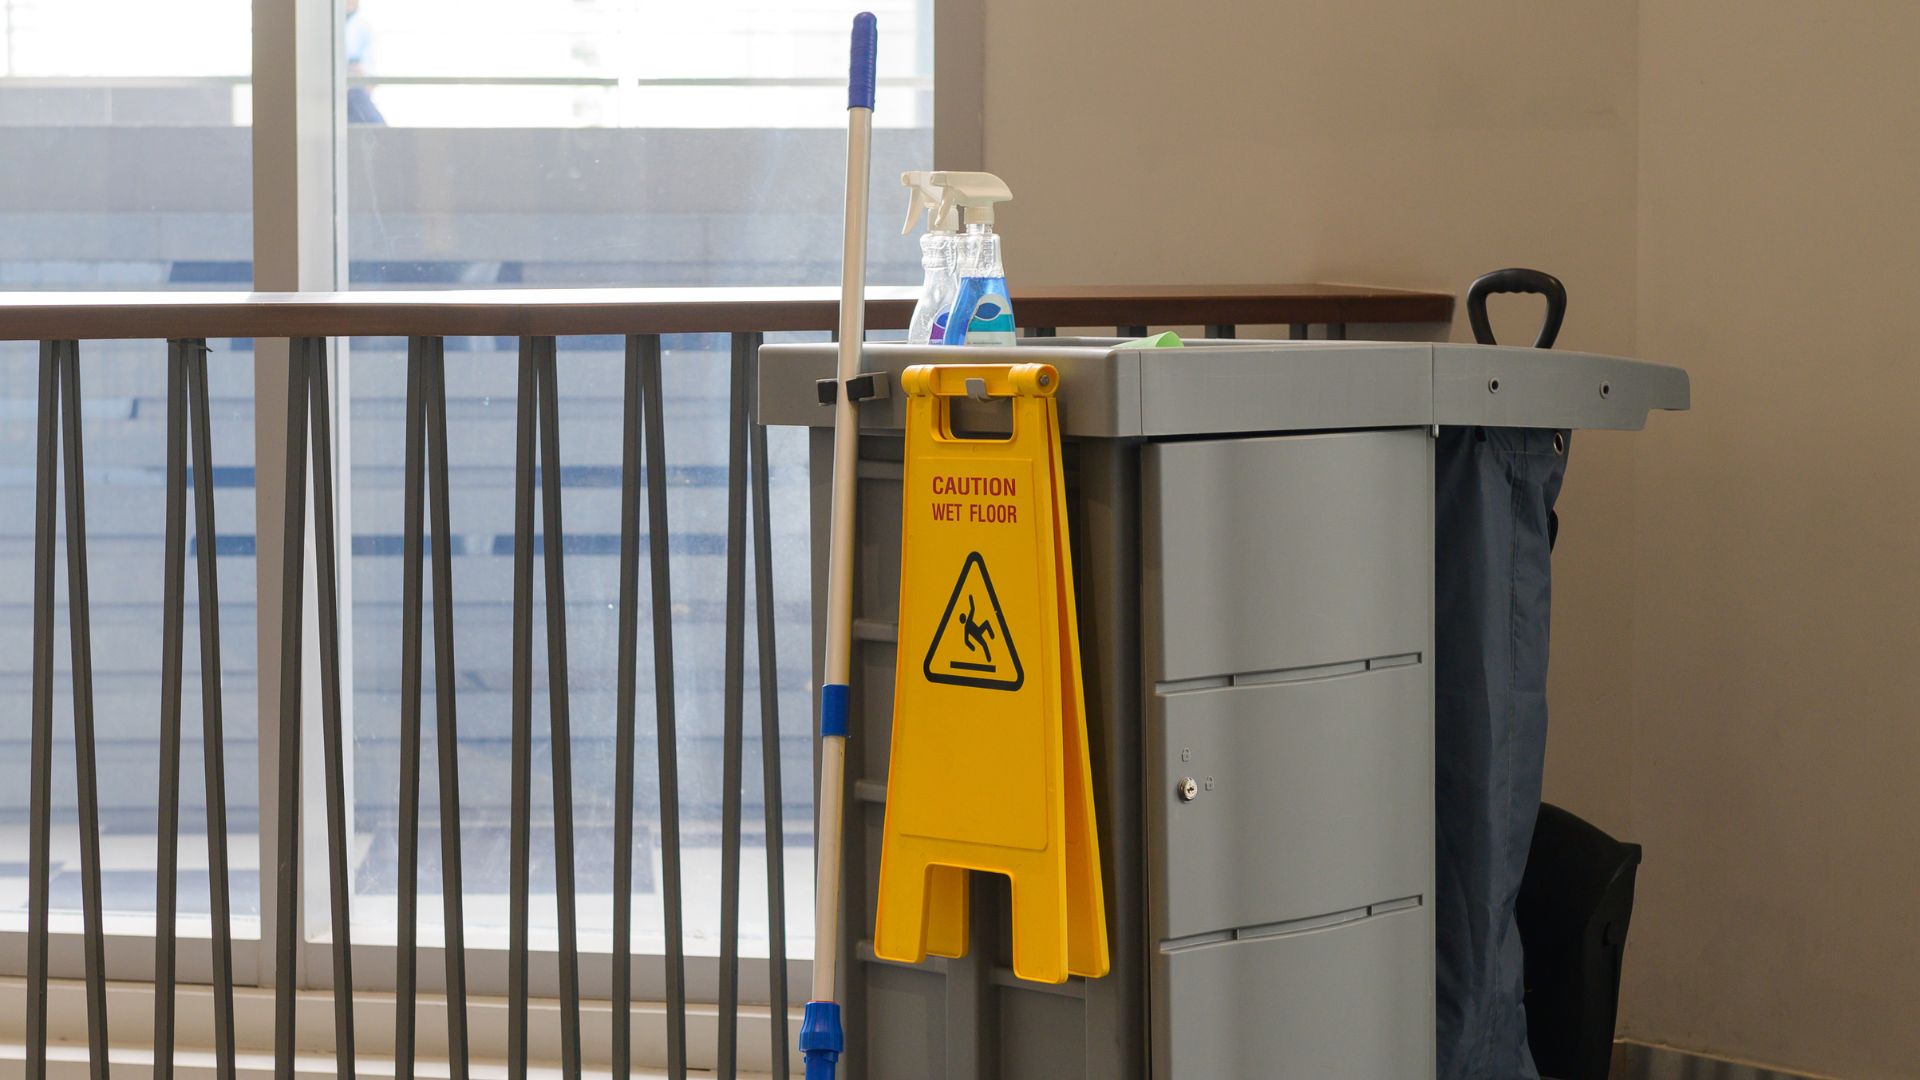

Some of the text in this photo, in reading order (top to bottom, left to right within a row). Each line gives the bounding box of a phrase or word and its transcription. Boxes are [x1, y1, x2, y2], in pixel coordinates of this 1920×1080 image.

[932, 476, 1016, 496] CAUTION
[932, 503, 1017, 523] WET FLOOR
